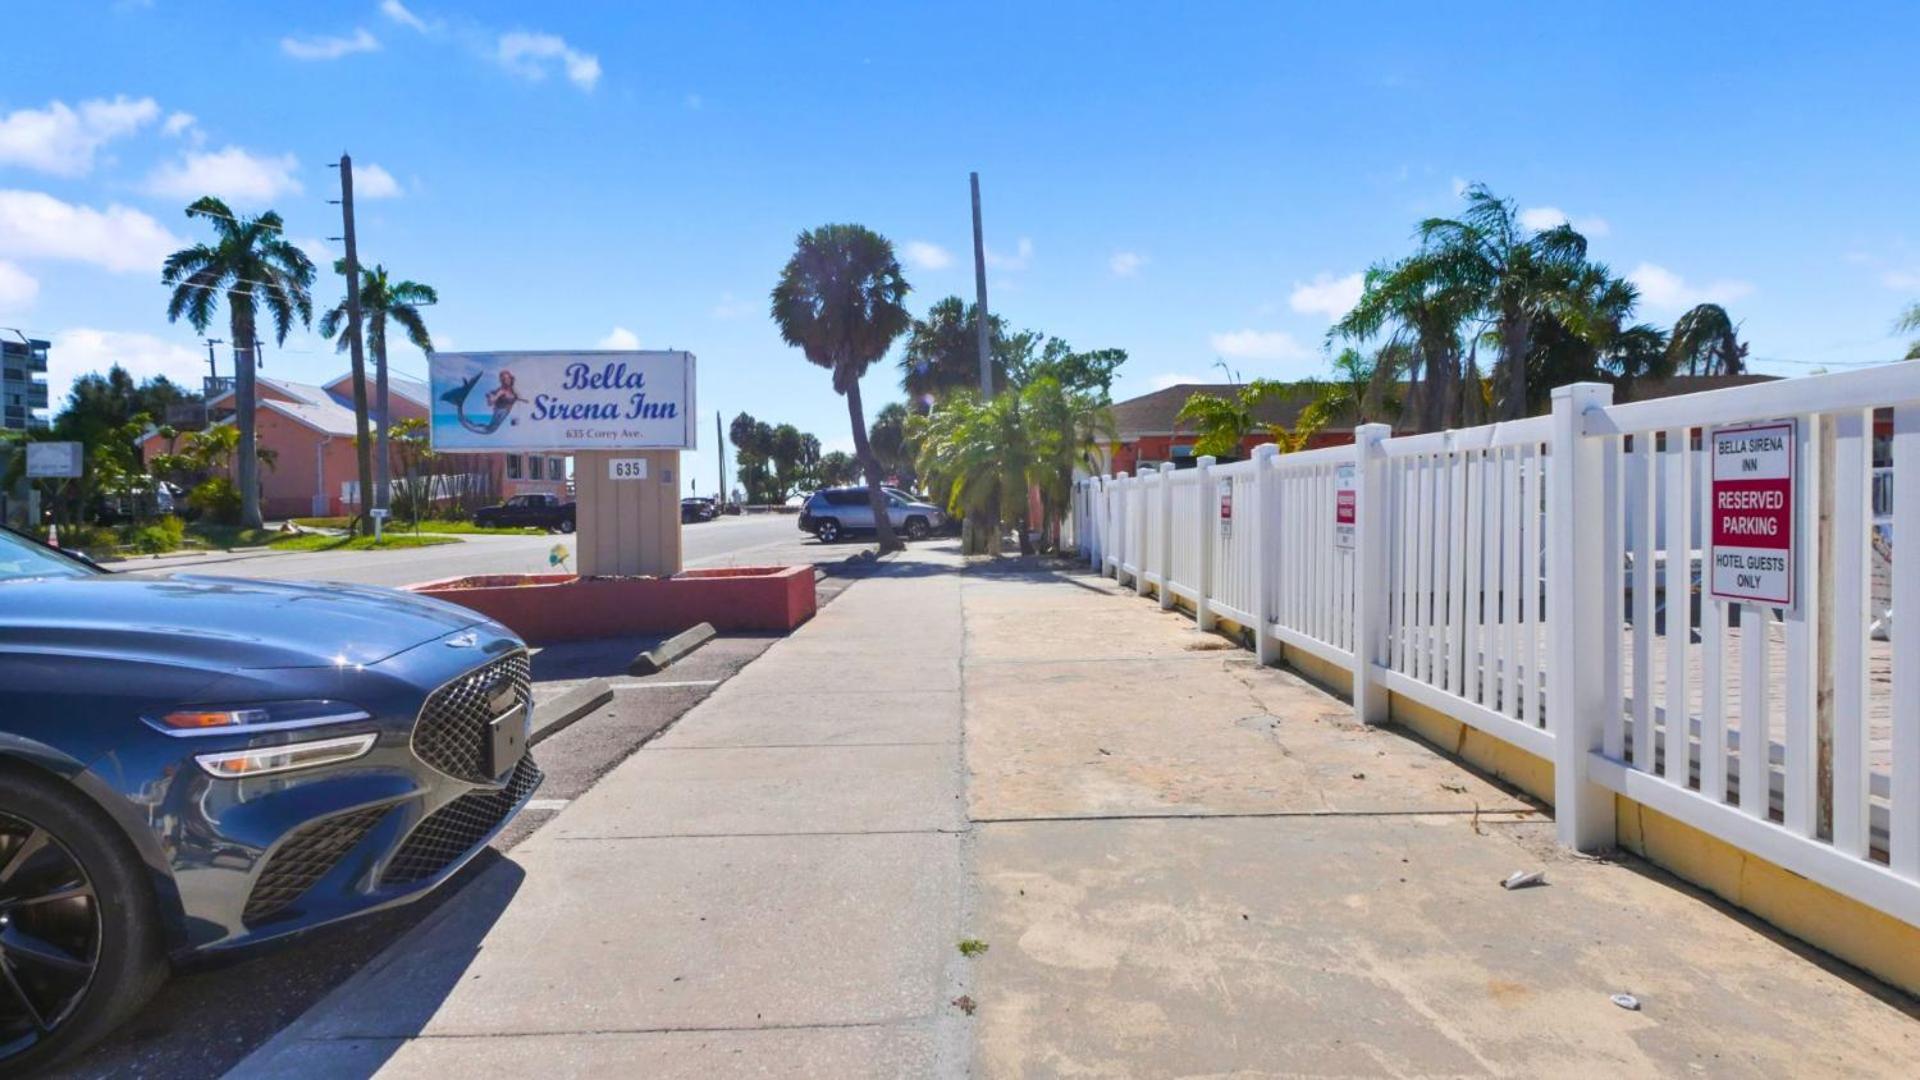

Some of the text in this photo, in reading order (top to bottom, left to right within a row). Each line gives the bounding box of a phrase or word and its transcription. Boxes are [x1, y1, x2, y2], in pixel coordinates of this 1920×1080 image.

[563, 362, 646, 390] Bella
[531, 392, 678, 421] Sirena Inn
[566, 429, 583, 438] 635
[622, 429, 643, 438] Ave.
[1718, 437, 1783, 454] BELLA SIRENA
[616, 463, 640, 476] 635
[1742, 458, 1757, 471] INN
[1718, 491, 1783, 509] RESERVED
[1723, 516, 1777, 535] PARKING
[1716, 554, 1784, 571] HOTEL GUESTS
[1737, 574, 1761, 588] ONLY
